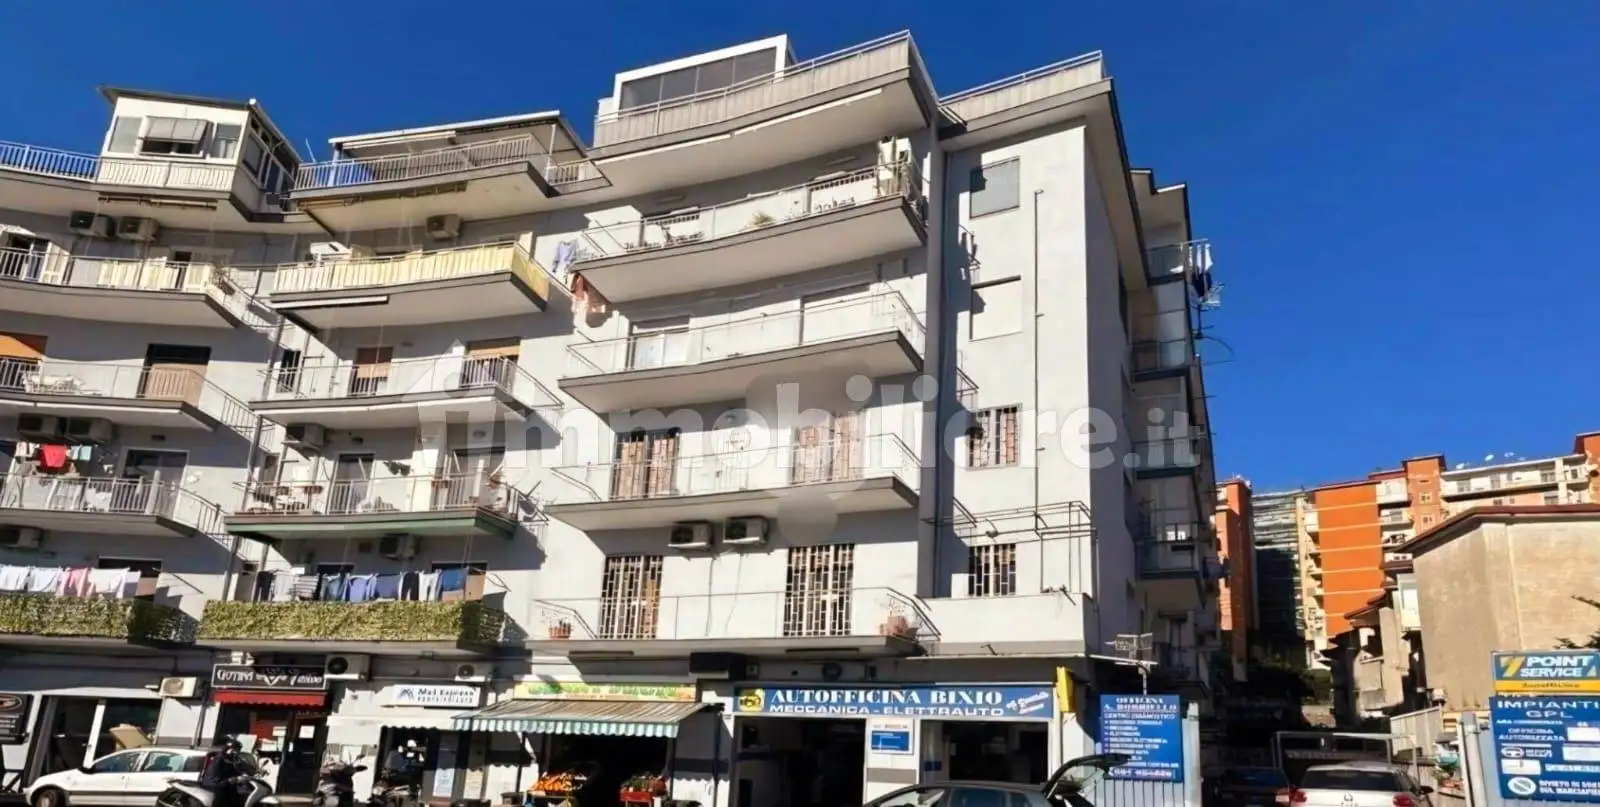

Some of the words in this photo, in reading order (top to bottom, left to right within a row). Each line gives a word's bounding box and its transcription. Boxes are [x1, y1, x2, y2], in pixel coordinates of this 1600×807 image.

[1525, 655, 1595, 667] POINT
[1519, 667, 1583, 678] SERVICE
[770, 688, 921, 705] AUTOFFICINA
[929, 689, 1004, 706] BIXIO
[1497, 700, 1600, 709] IMPIANTI
[769, 704, 871, 715] MECCANICA
[883, 705, 1005, 717] ELETTRAUTO
[1526, 710, 1574, 718] GPL
